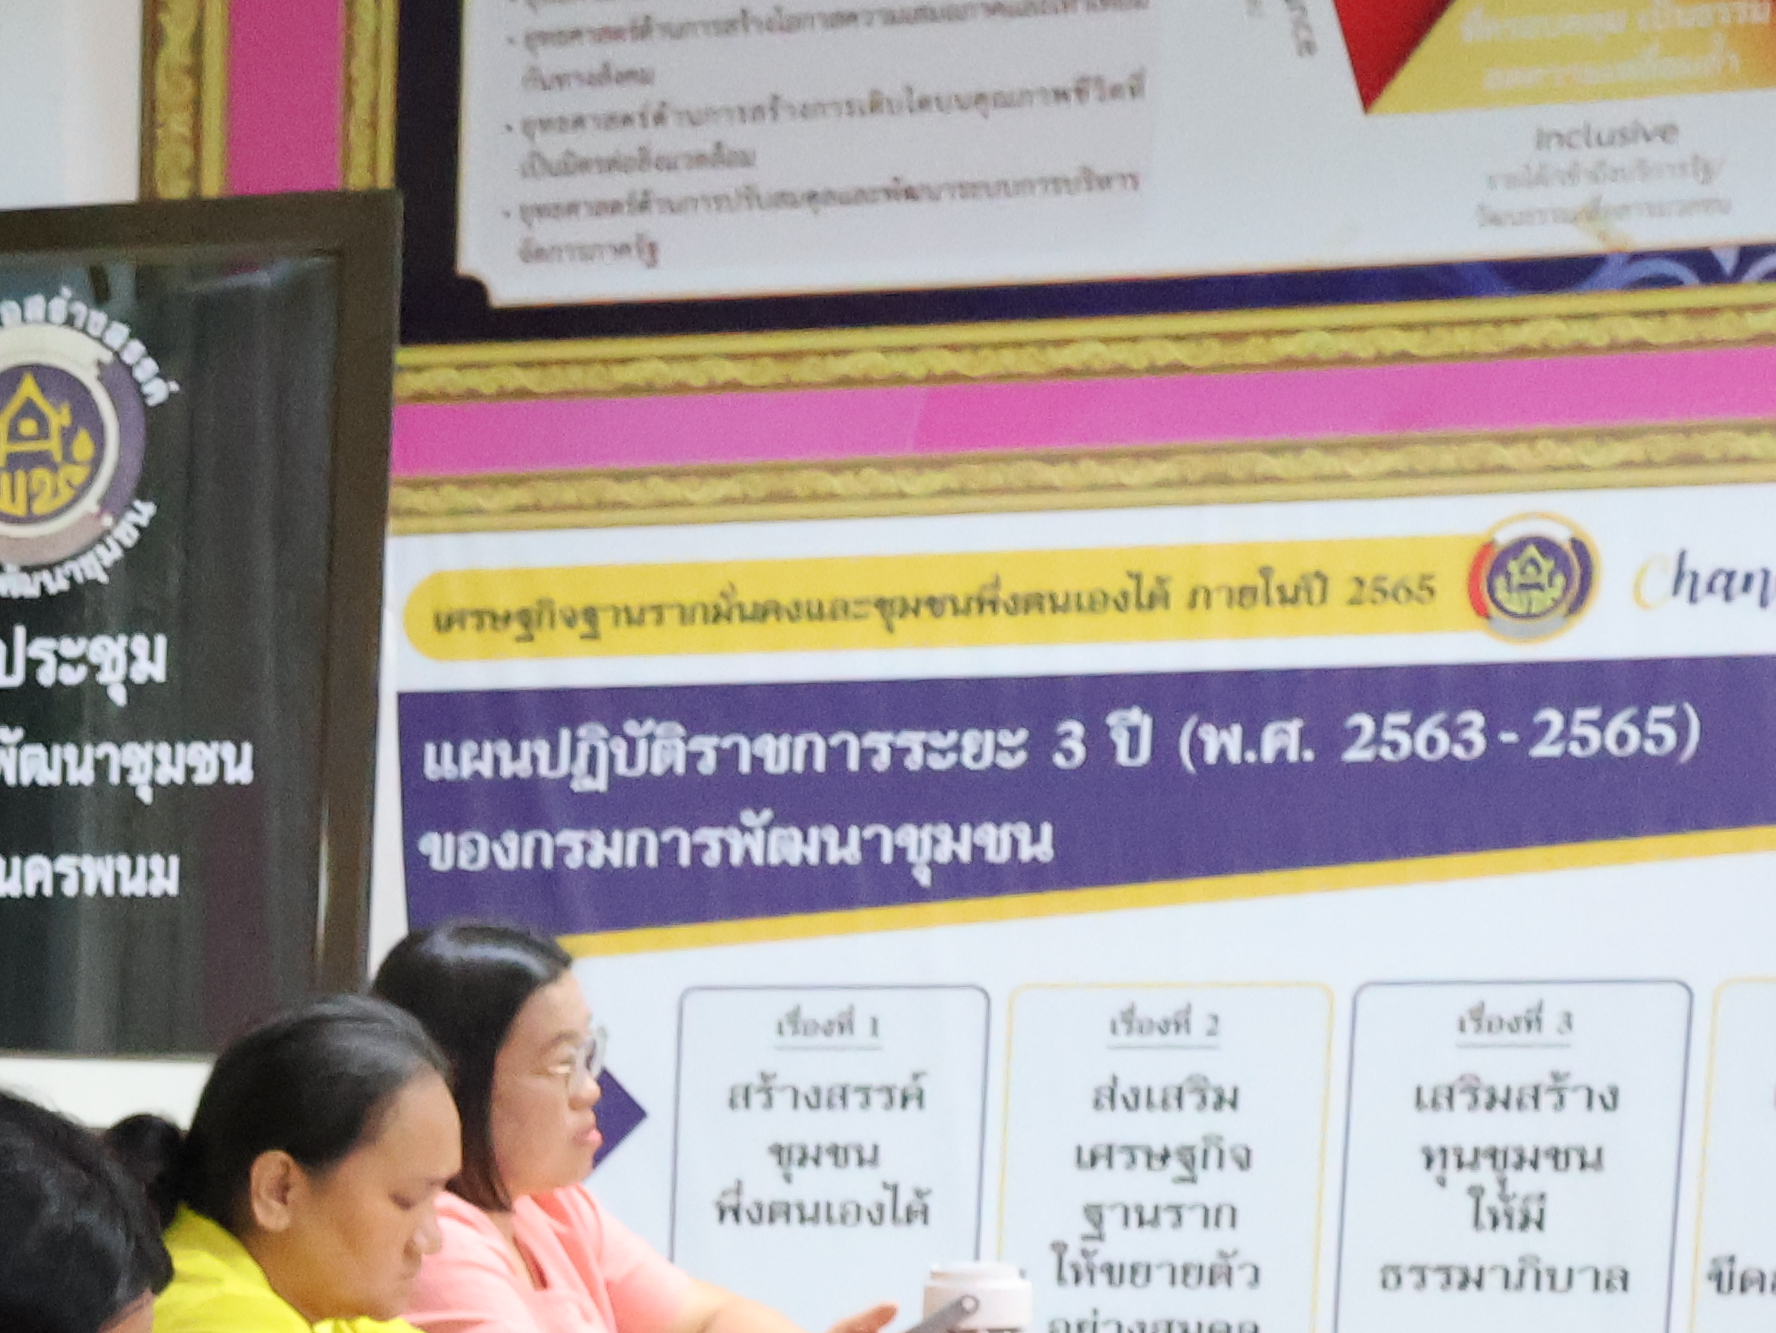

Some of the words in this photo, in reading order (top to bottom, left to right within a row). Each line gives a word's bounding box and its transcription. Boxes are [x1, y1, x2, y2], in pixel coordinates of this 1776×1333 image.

[1534, 119, 1680, 151] Inclusive
[1346, 573, 1435, 607] 2565
[423, 718, 1029, 792] แผนปฏิบัติราชการระยะ
[1052, 719, 1087, 770] 3
[1106, 705, 1154, 768] ปี
[1341, 710, 1487, 763] 2563
[419, 808, 1054, 888] ของกรมการพัฒนาชุมชน
[1205, 1012, 1220, 1037] 2
[728, 1070, 928, 1111] สร้างสรรค์
[1092, 1072, 1240, 1112] ส่งเสริม
[1414, 1070, 1620, 1113] เสริมสร้าง
[768, 1142, 880, 1184] ชุมชน
[1075, 1132, 1252, 1184] เศรษฐกิจ
[1420, 1143, 1604, 1190] ทุนชุมชน
[1080, 1202, 1238, 1242] ฐานราก
[1050, 1240, 1261, 1289] ให้ขยายตัว
[1379, 1254, 1630, 1294] ธรรมาภิบาล
